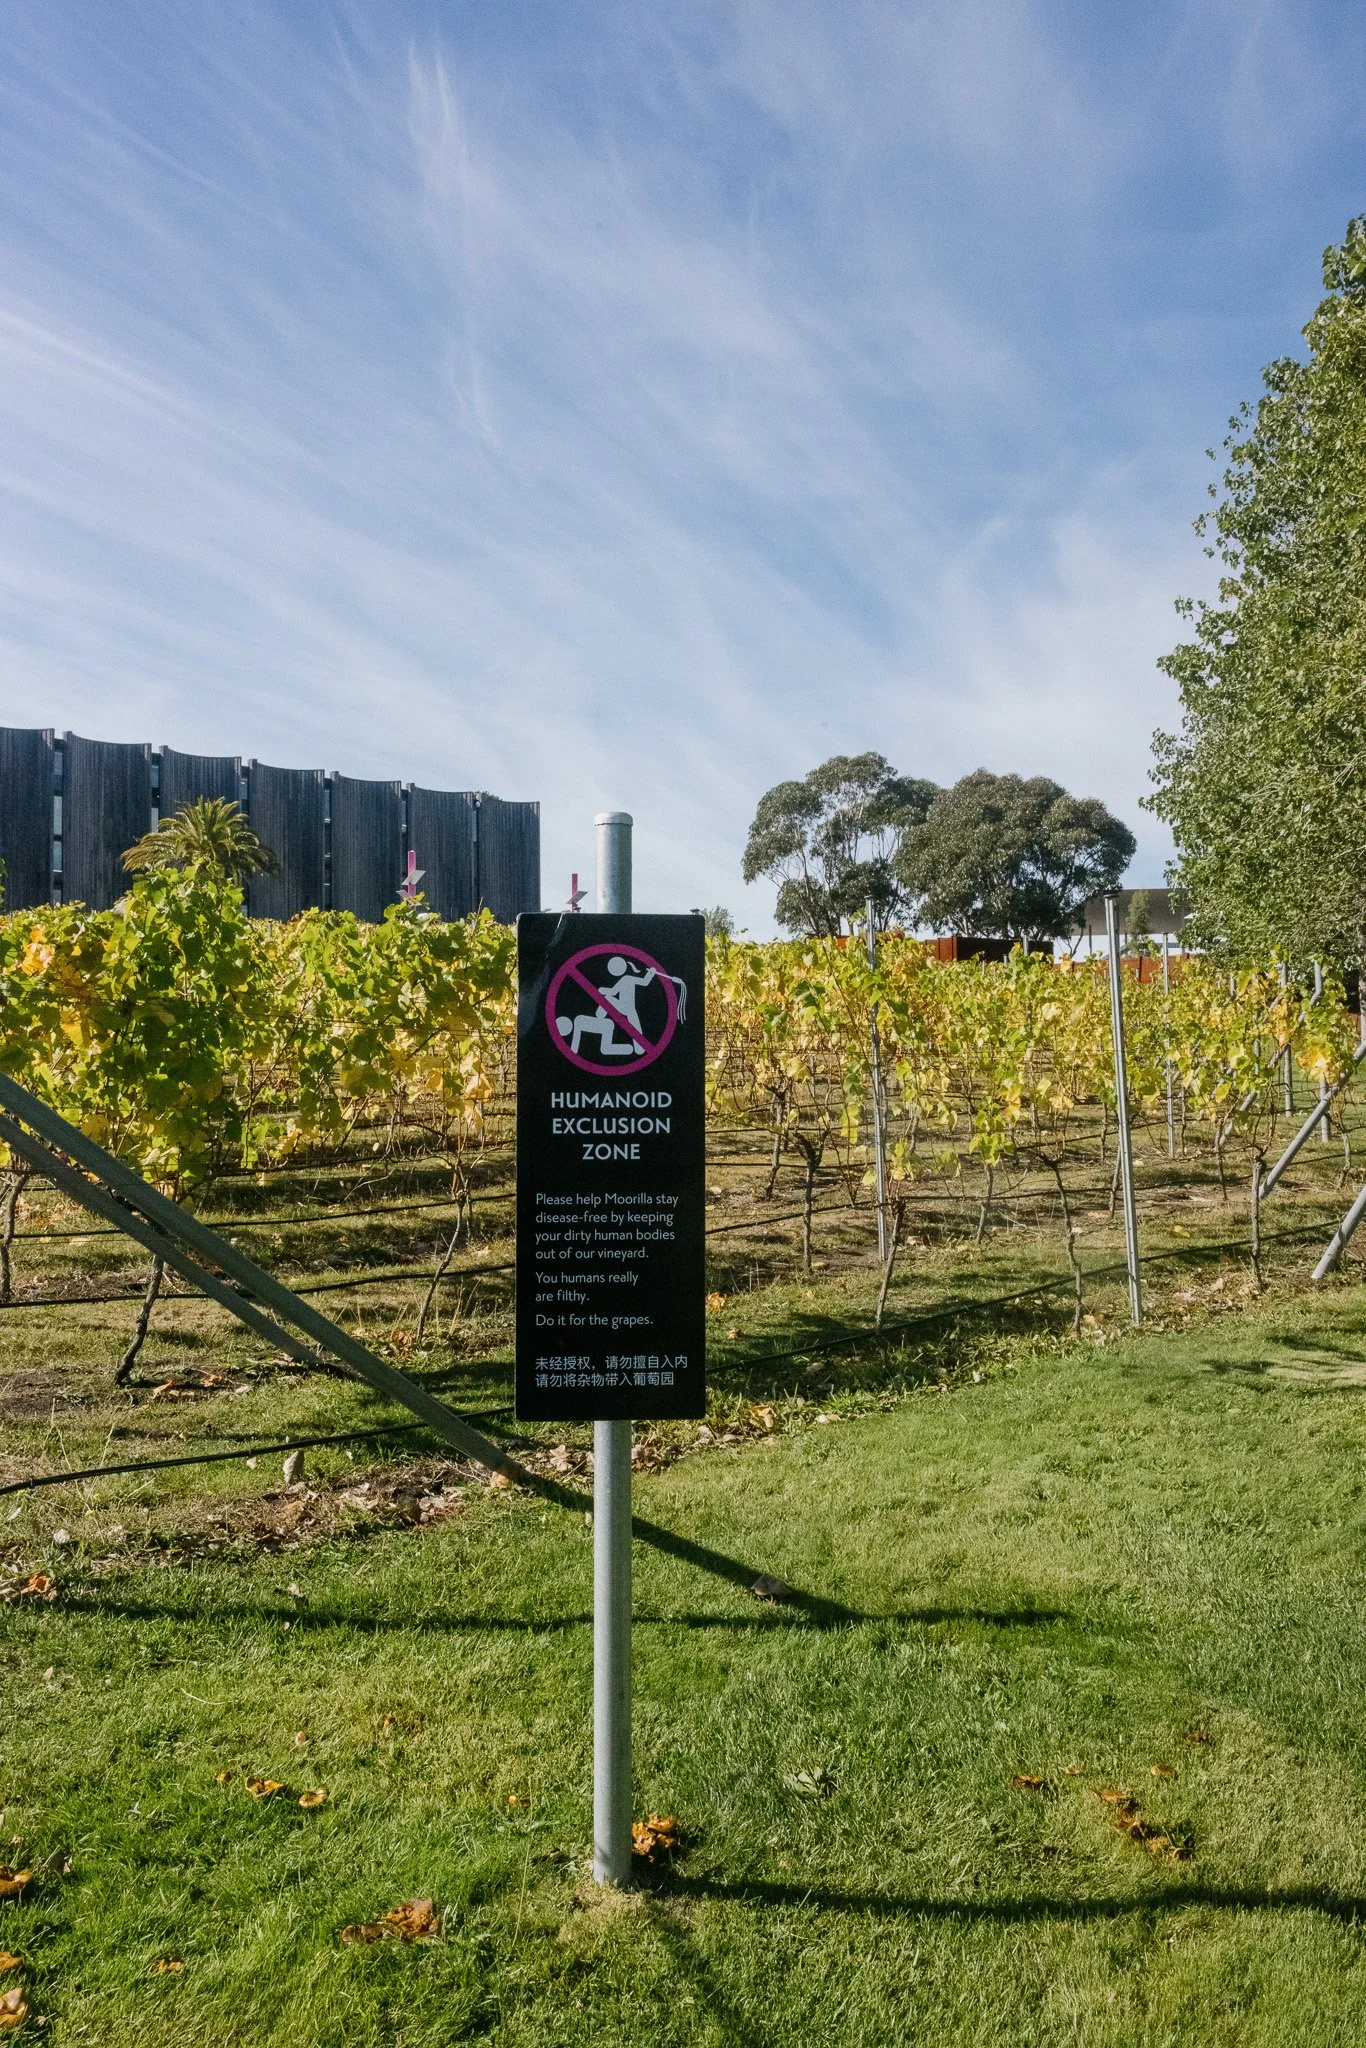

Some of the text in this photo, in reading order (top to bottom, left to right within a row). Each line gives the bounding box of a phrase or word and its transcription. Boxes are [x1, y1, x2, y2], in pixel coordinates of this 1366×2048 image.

[549, 1091, 673, 1109] HUMANOID
[551, 1117, 671, 1135] EXCLUSION
[582, 1143, 641, 1161] ZONE
[536, 1193, 679, 1208] Please help Moorilla stay
[535, 1211, 674, 1226] disease-free by keeping
[535, 1228, 675, 1245] your dirty human bodies
[535, 1247, 649, 1262] out of our vineyard.
[535, 1271, 639, 1286] You humans really
[535, 1290, 590, 1305] are filthy.
[535, 1314, 654, 1330] Do it for the grapes.
[535, 1371, 675, 1388] 请勿将杂物带入葡萄园
